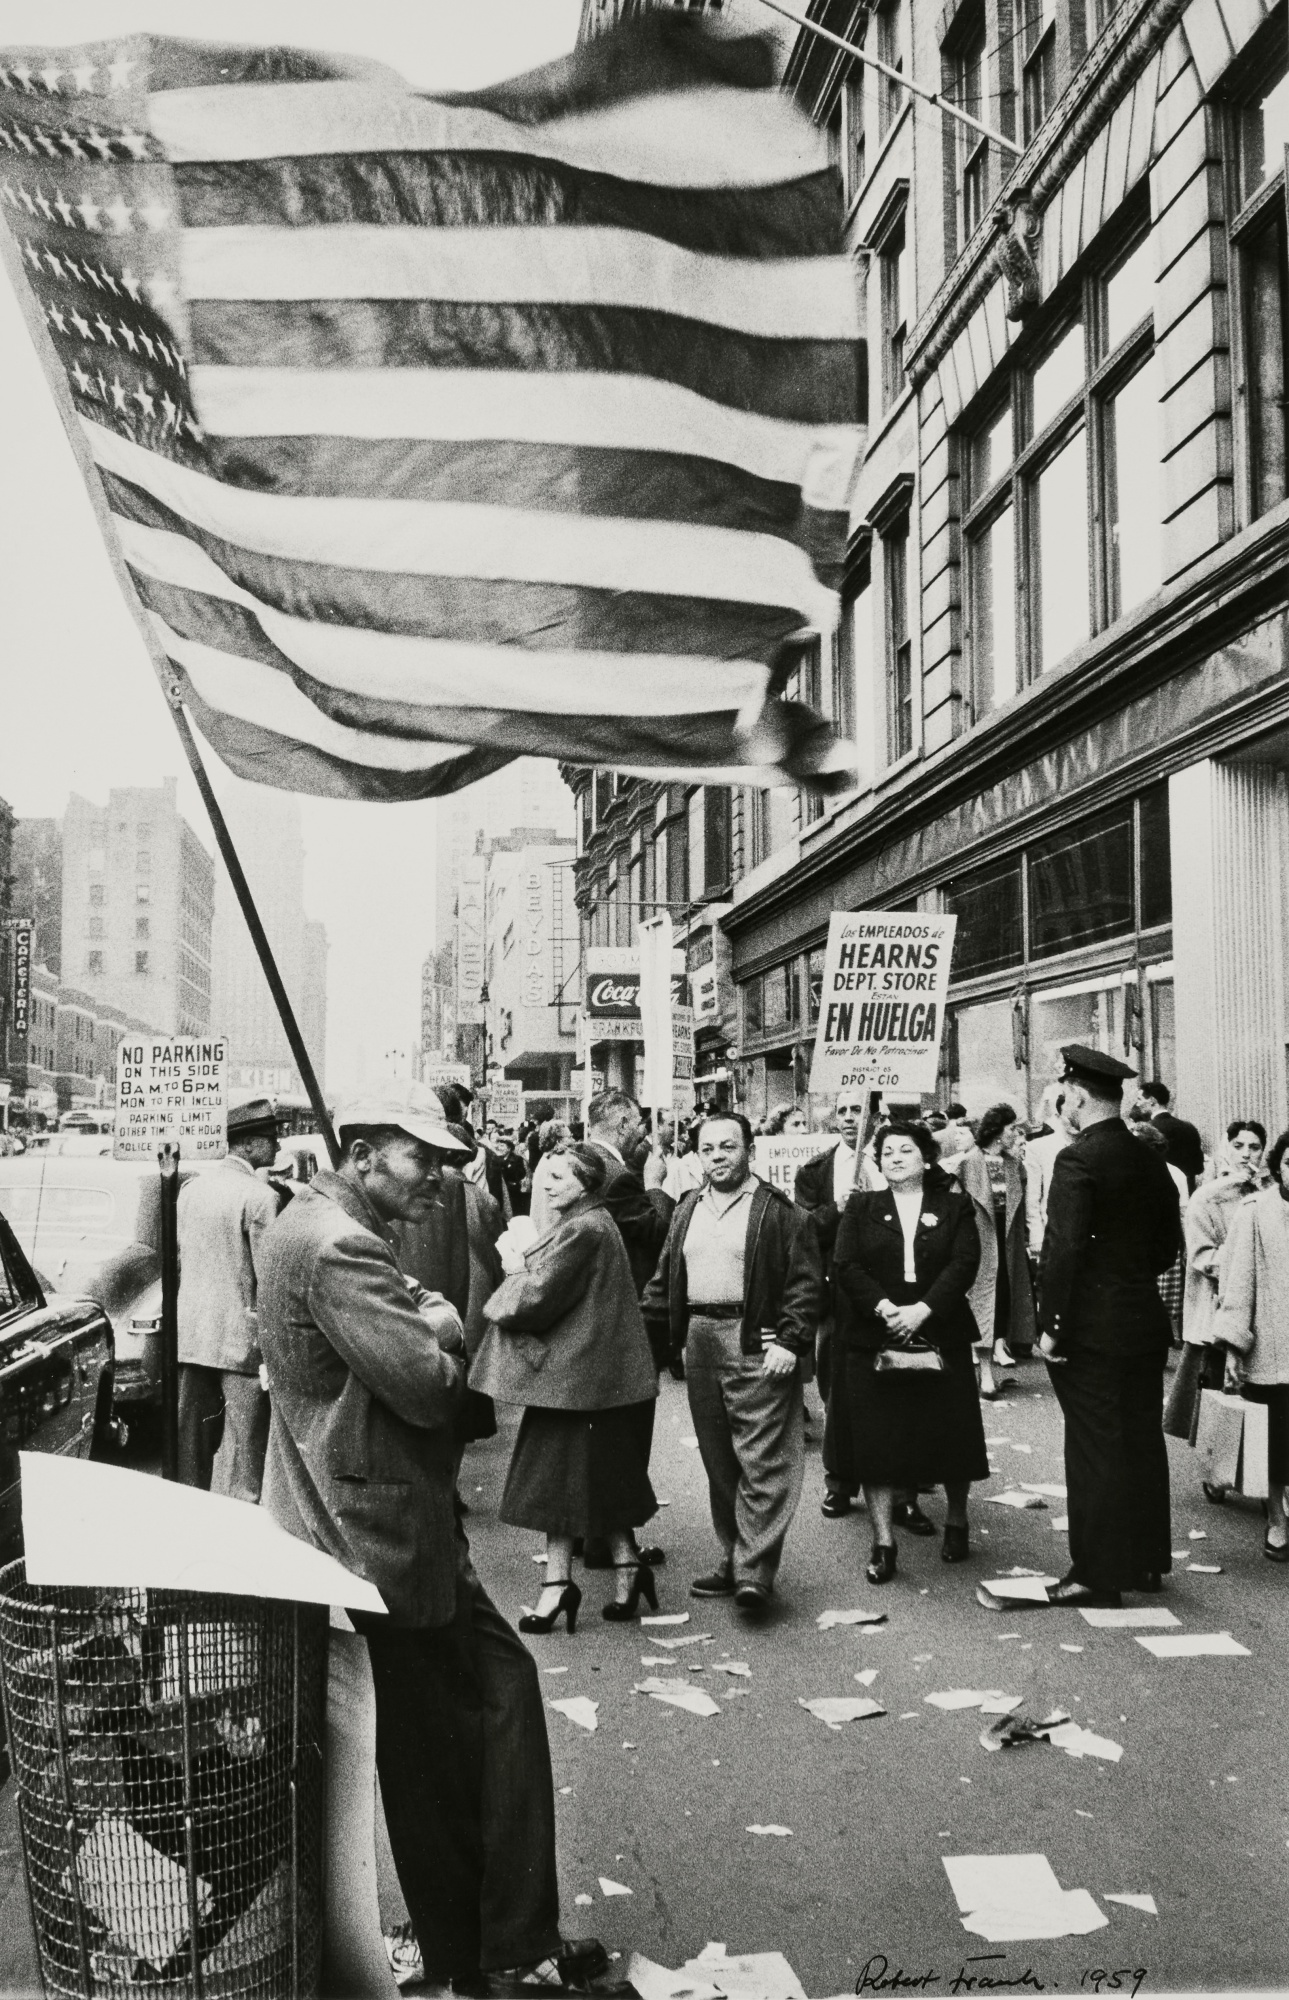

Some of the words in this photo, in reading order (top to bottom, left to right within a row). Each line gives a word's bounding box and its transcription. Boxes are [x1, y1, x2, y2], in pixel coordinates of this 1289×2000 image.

[840, 924, 856, 939] Los
[858, 925, 930, 939] EMPLEADOS
[931, 926, 946, 939] de
[838, 943, 940, 969] HEARNS
[833, 972, 877, 991] DEPT.
[882, 972, 938, 991] STORE
[824, 1002, 855, 1043] EN
[858, 1002, 937, 1042] HUELGA
[122, 1046, 144, 1064] NO
[152, 1043, 224, 1063] PARKING
[825, 1045, 849, 1057] Favor
[865, 1046, 877, 1056] No
[879, 1045, 929, 1057] Patrocinar
[125, 1067, 142, 1078] ON
[150, 1065, 181, 1077] THIS
[188, 1064, 220, 1076] SIDE
[842, 1074, 866, 1086] DPO
[878, 1074, 900, 1085] CIO
[151, 1097, 163, 1105] TO
[167, 1096, 186, 1107] FRI
[192, 1095, 222, 1106] INCLU
[129, 1112, 174, 1124] PARKING
[181, 1112, 212, 1123] LIMIT
[119, 1126, 147, 1137] OTHER
[179, 1125, 195, 1136] ONE
[198, 1124, 222, 1136] HOUR
